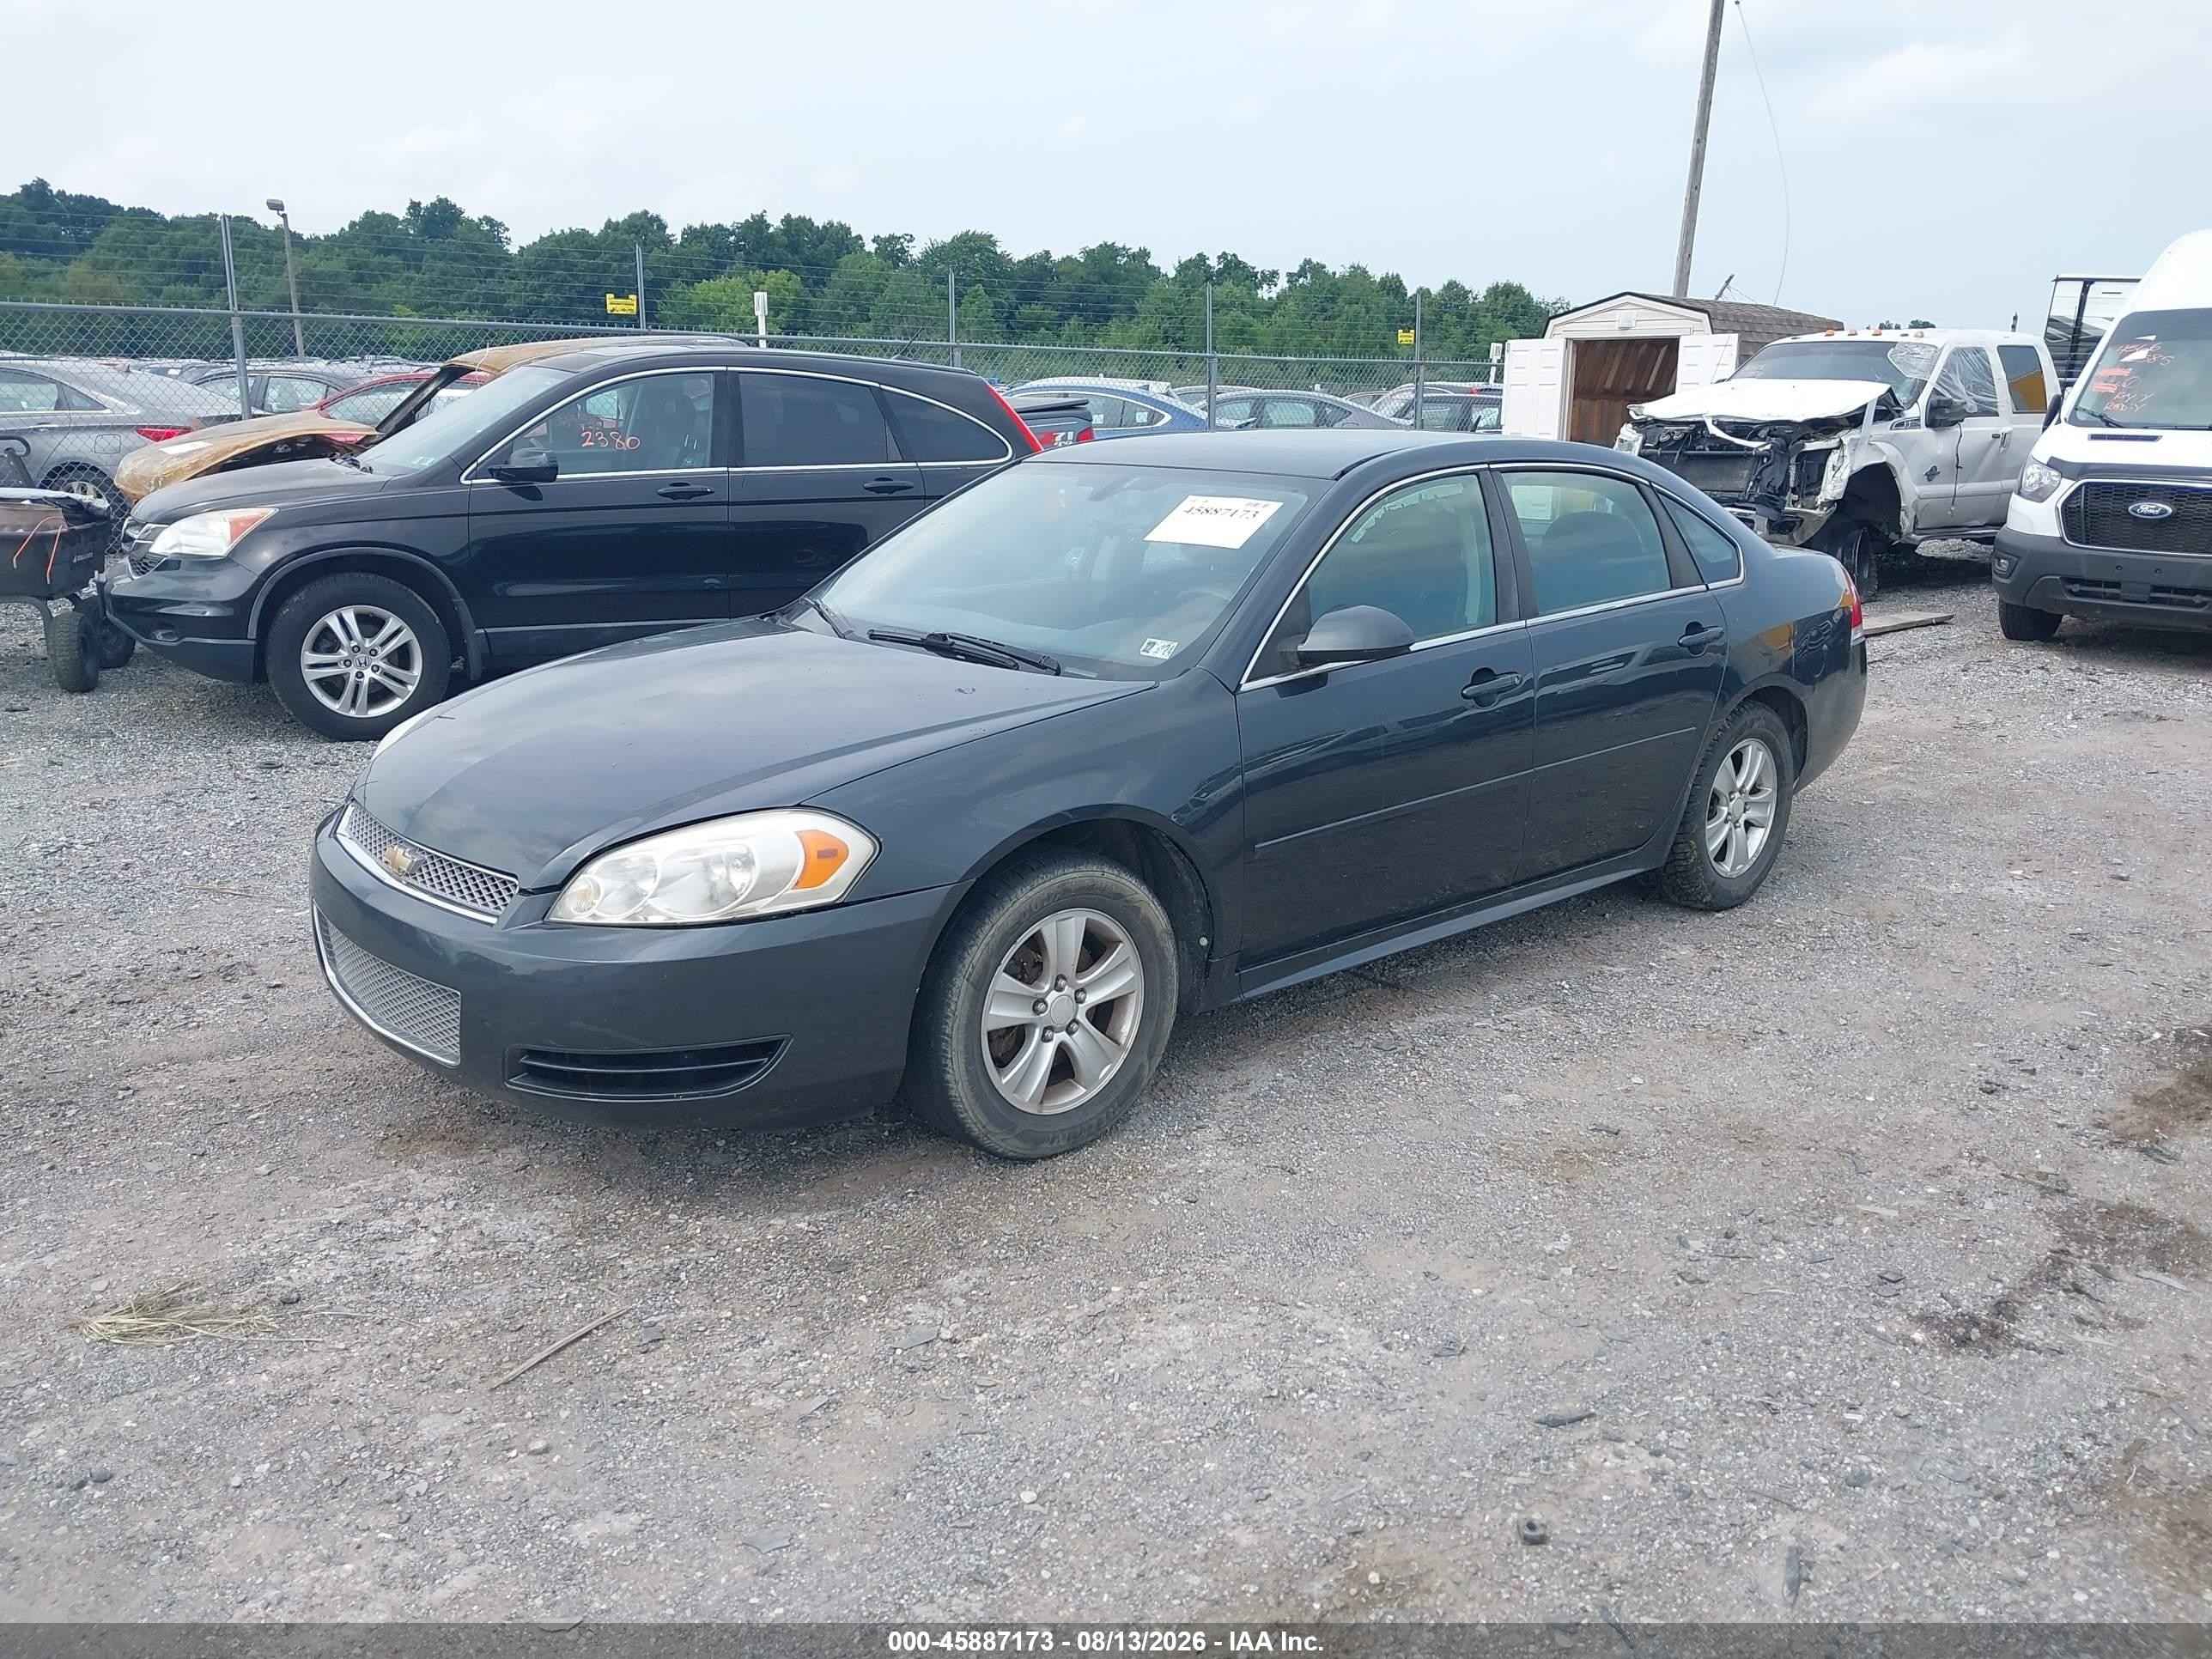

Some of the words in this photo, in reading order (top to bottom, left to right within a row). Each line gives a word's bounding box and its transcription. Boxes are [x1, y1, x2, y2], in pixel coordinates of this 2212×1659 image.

[580, 431, 641, 450] 2380
[1182, 505, 1261, 520] 45887173
[2136, 504, 2162, 515] Ford
